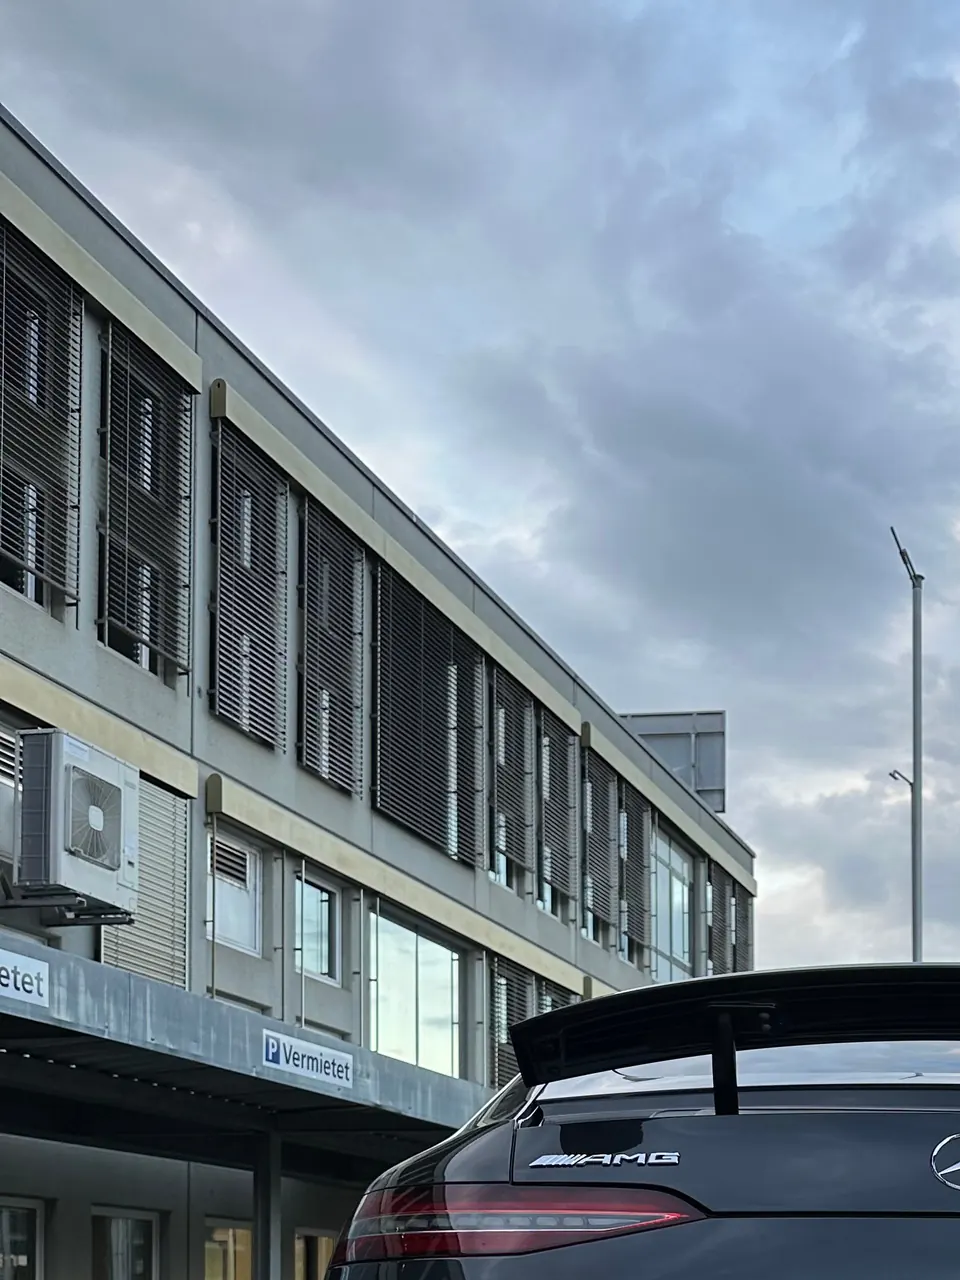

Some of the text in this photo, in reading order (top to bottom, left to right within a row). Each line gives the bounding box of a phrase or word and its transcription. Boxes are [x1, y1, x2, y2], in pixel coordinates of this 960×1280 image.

[268, 1037, 350, 1081] P Vermietet
[574, 1152, 681, 1166] AMG
